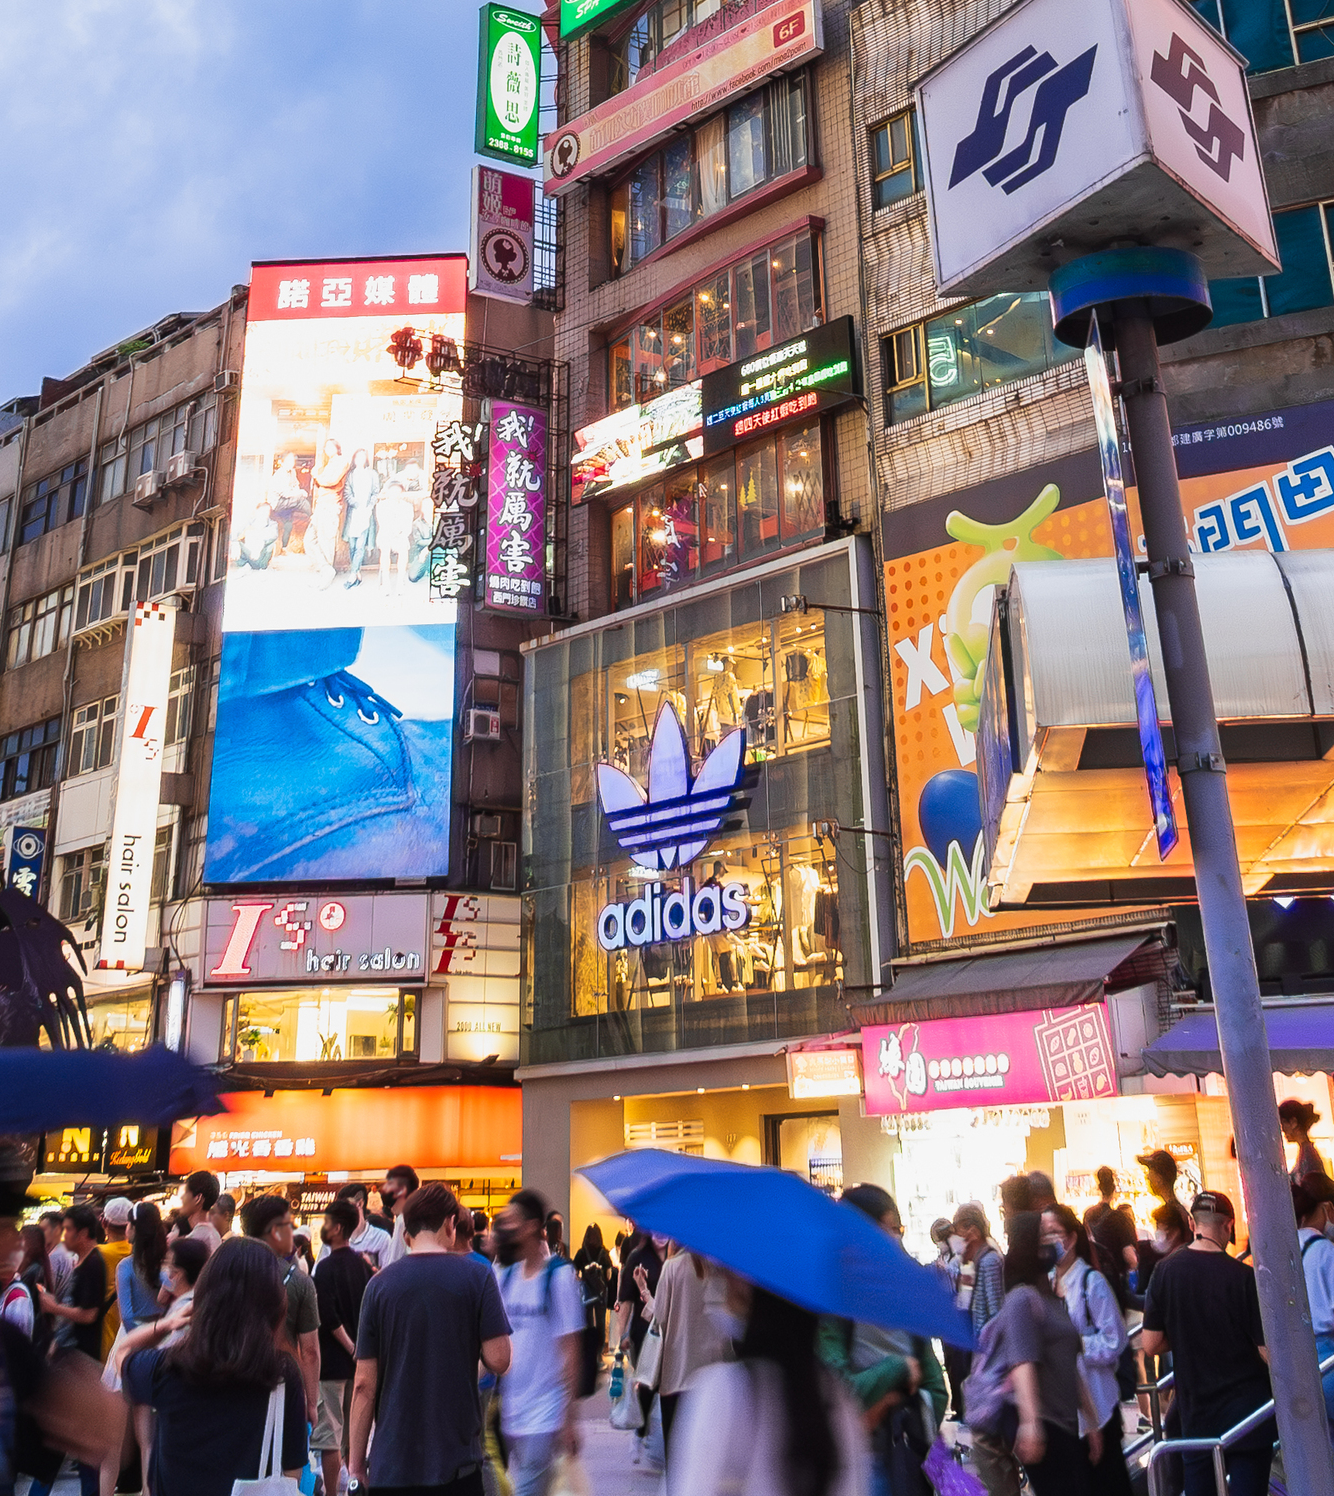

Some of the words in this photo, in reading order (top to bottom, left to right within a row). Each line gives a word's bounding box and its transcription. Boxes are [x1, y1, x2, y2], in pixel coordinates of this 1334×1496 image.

[779, 18, 799, 41] 6F
[506, 42, 521, 124] 詩薇思
[488, 136, 535, 159] 2388-8155
[277, 273, 439, 310] 諾亞媒體
[122, 834, 143, 877] hair
[113, 881, 136, 945] salon
[598, 875, 751, 952] adidas
[305, 948, 353, 973] hair
[357, 947, 422, 972] salon
[301, 1191, 337, 1204] TAIWAN
